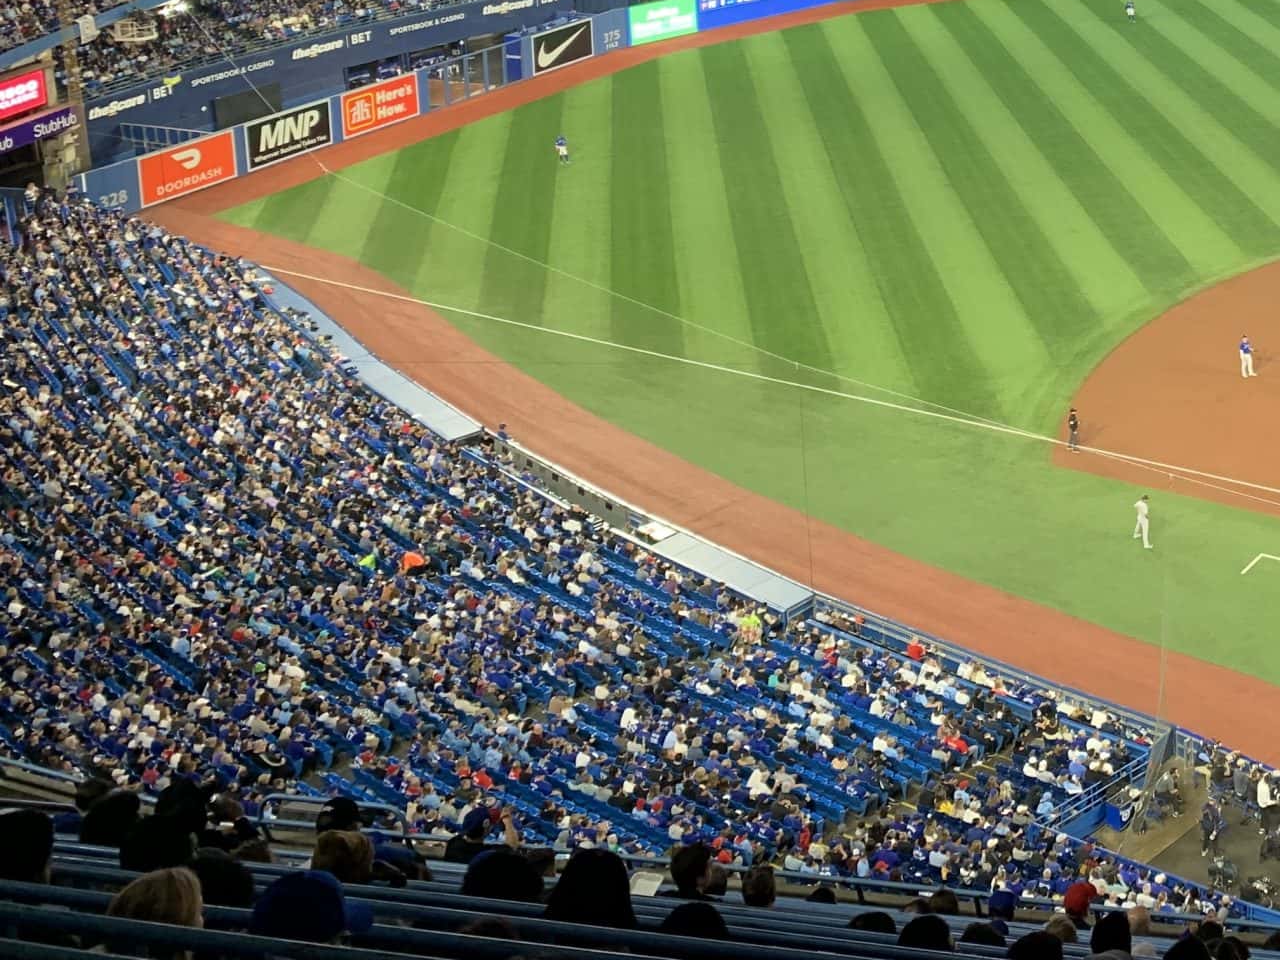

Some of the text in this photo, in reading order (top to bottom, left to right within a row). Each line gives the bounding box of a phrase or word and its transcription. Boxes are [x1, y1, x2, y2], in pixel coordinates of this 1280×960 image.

[390, 19, 434, 36] SPORTSBOOK
[440, 12, 466, 25] CASINO
[602, 29, 620, 42] 375
[292, 30, 372, 60] theScore BET
[191, 68, 240, 88] SPORTSBOOK
[247, 58, 275, 74] CASINO
[88, 84, 174, 121] theScore BET
[376, 84, 413, 103] Here's
[376, 103, 408, 120] How.
[33, 112, 78, 138] StubHub
[259, 110, 320, 153] MNP
[156, 166, 222, 196] DOORDASH
[100, 190, 129, 209] 328
